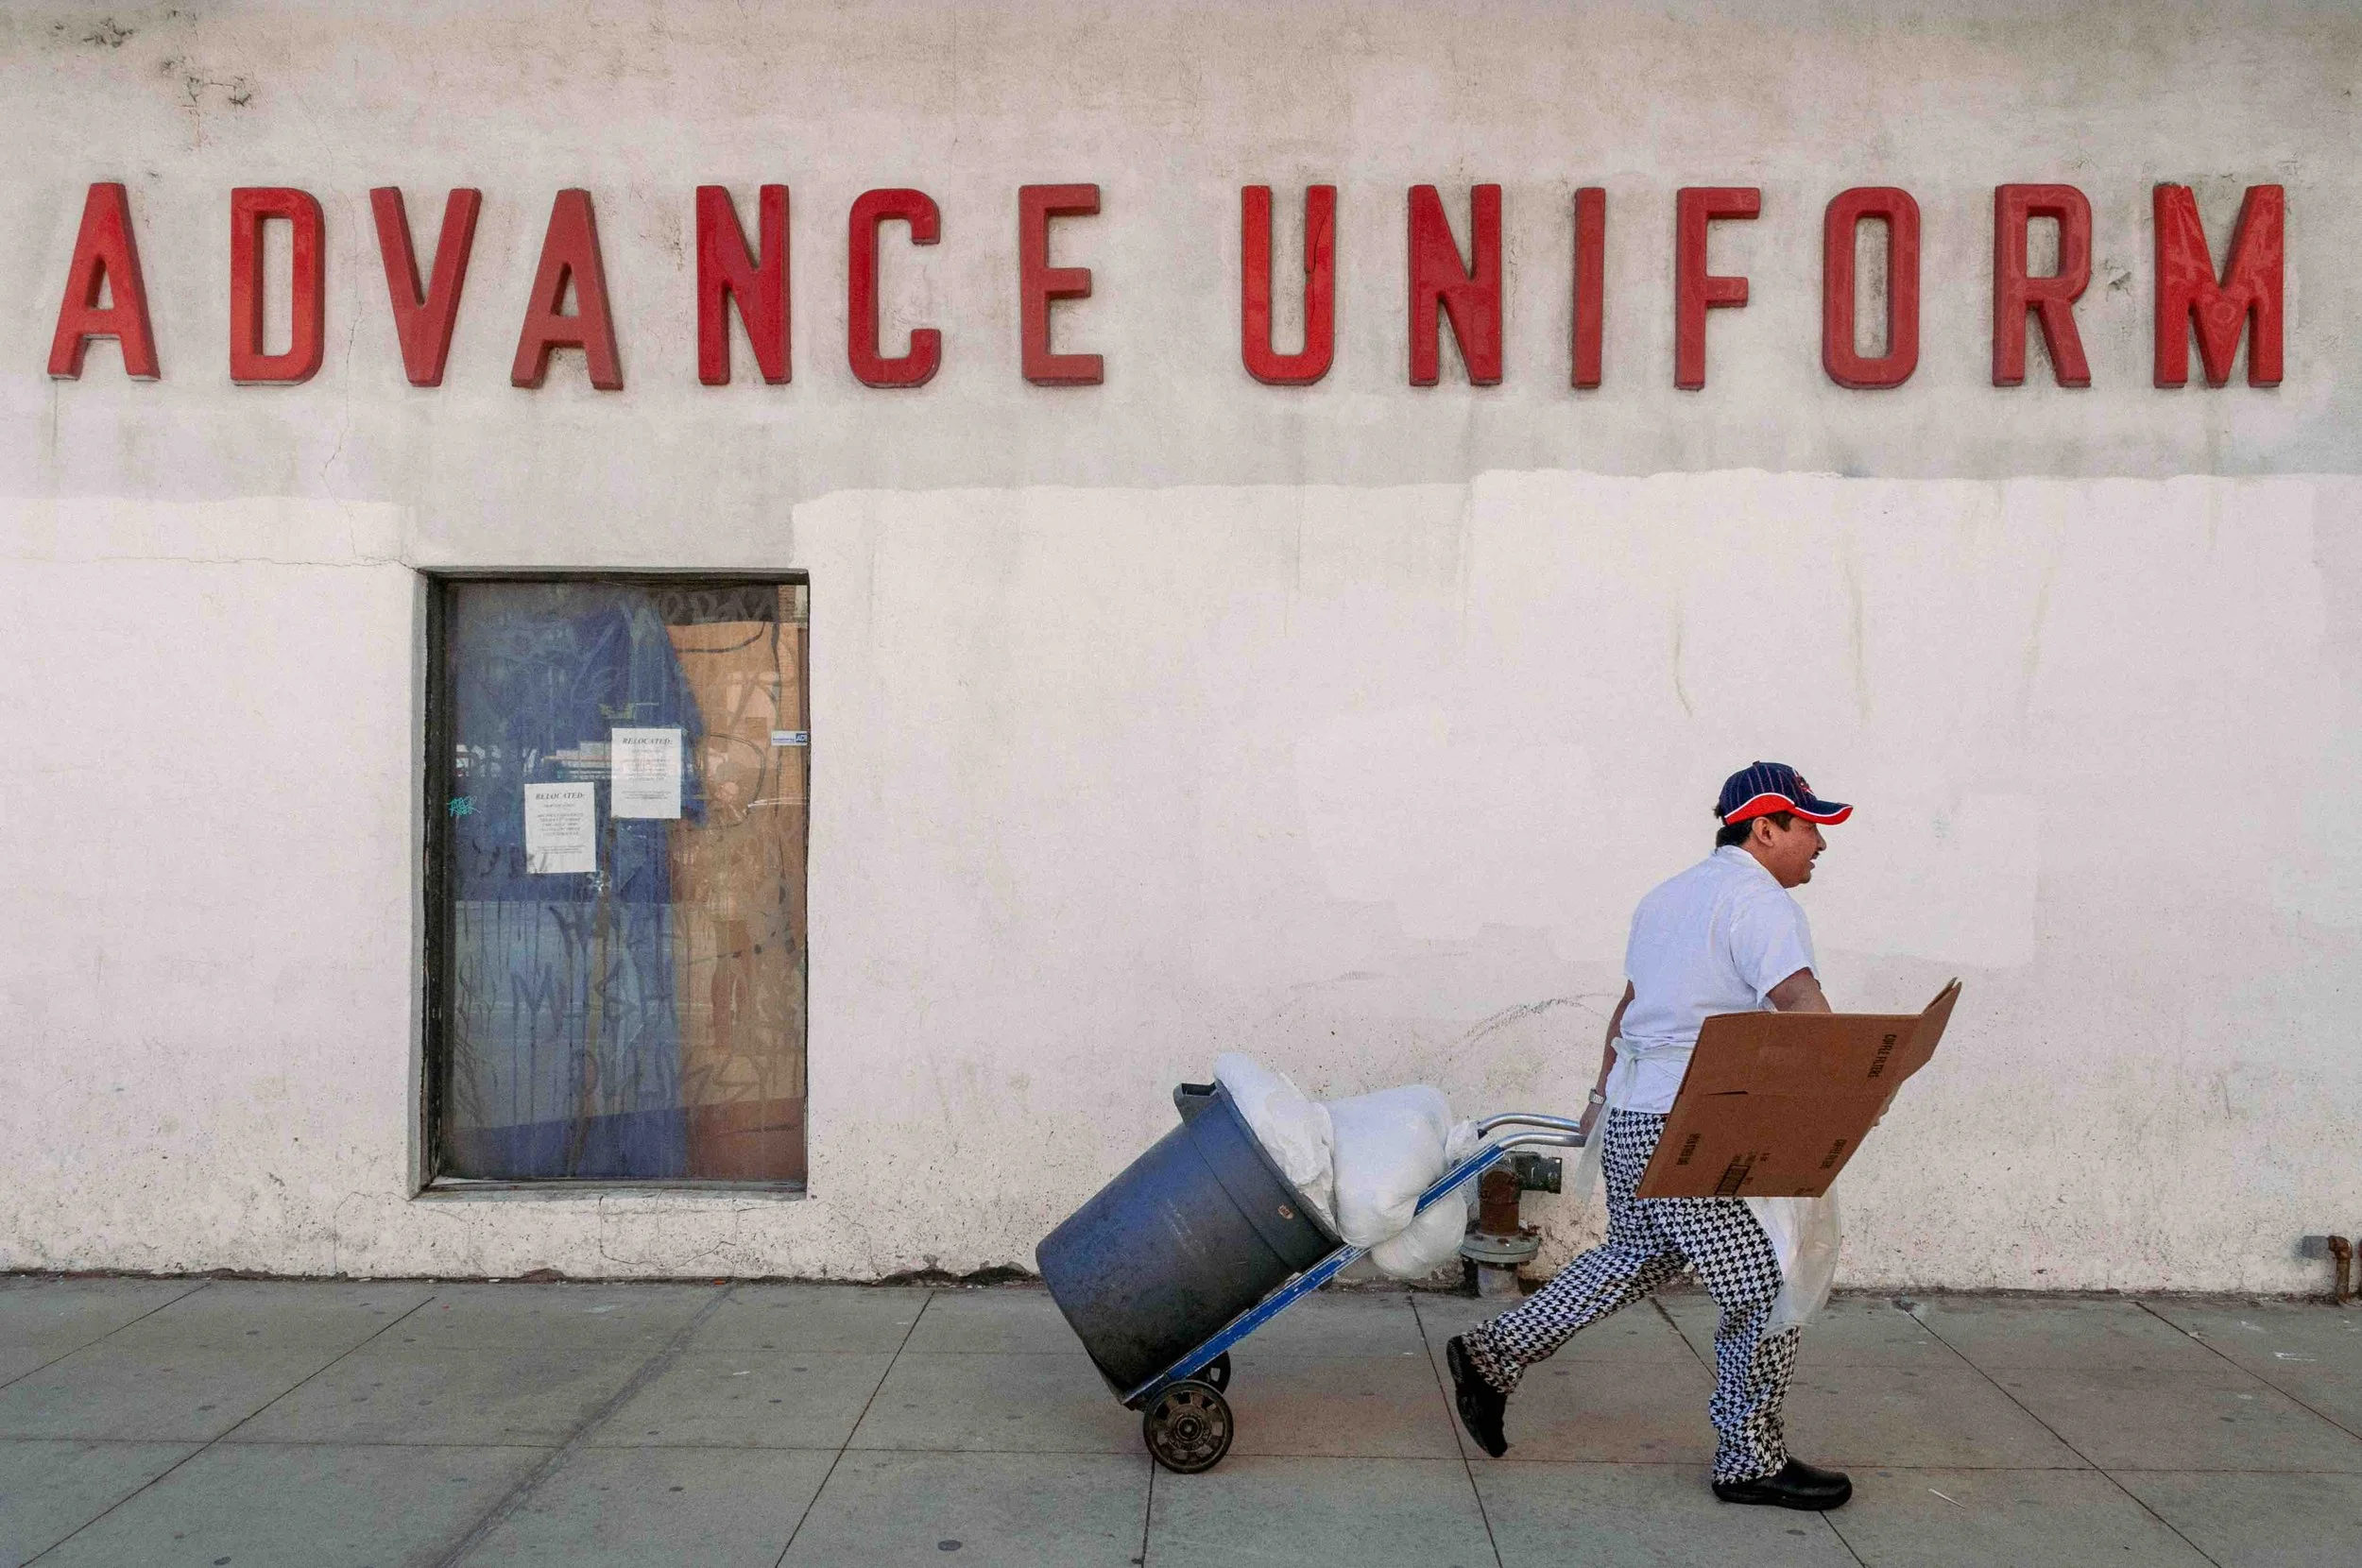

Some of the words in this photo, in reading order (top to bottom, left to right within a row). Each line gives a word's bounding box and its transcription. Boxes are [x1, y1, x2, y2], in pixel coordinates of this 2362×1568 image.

[46, 182, 1104, 390] ADVANCE
[1241, 182, 2285, 390] UNIFORM
[1876, 1033, 1897, 1056] COFFEE
[1867, 1056, 1887, 1078] FILTERS
